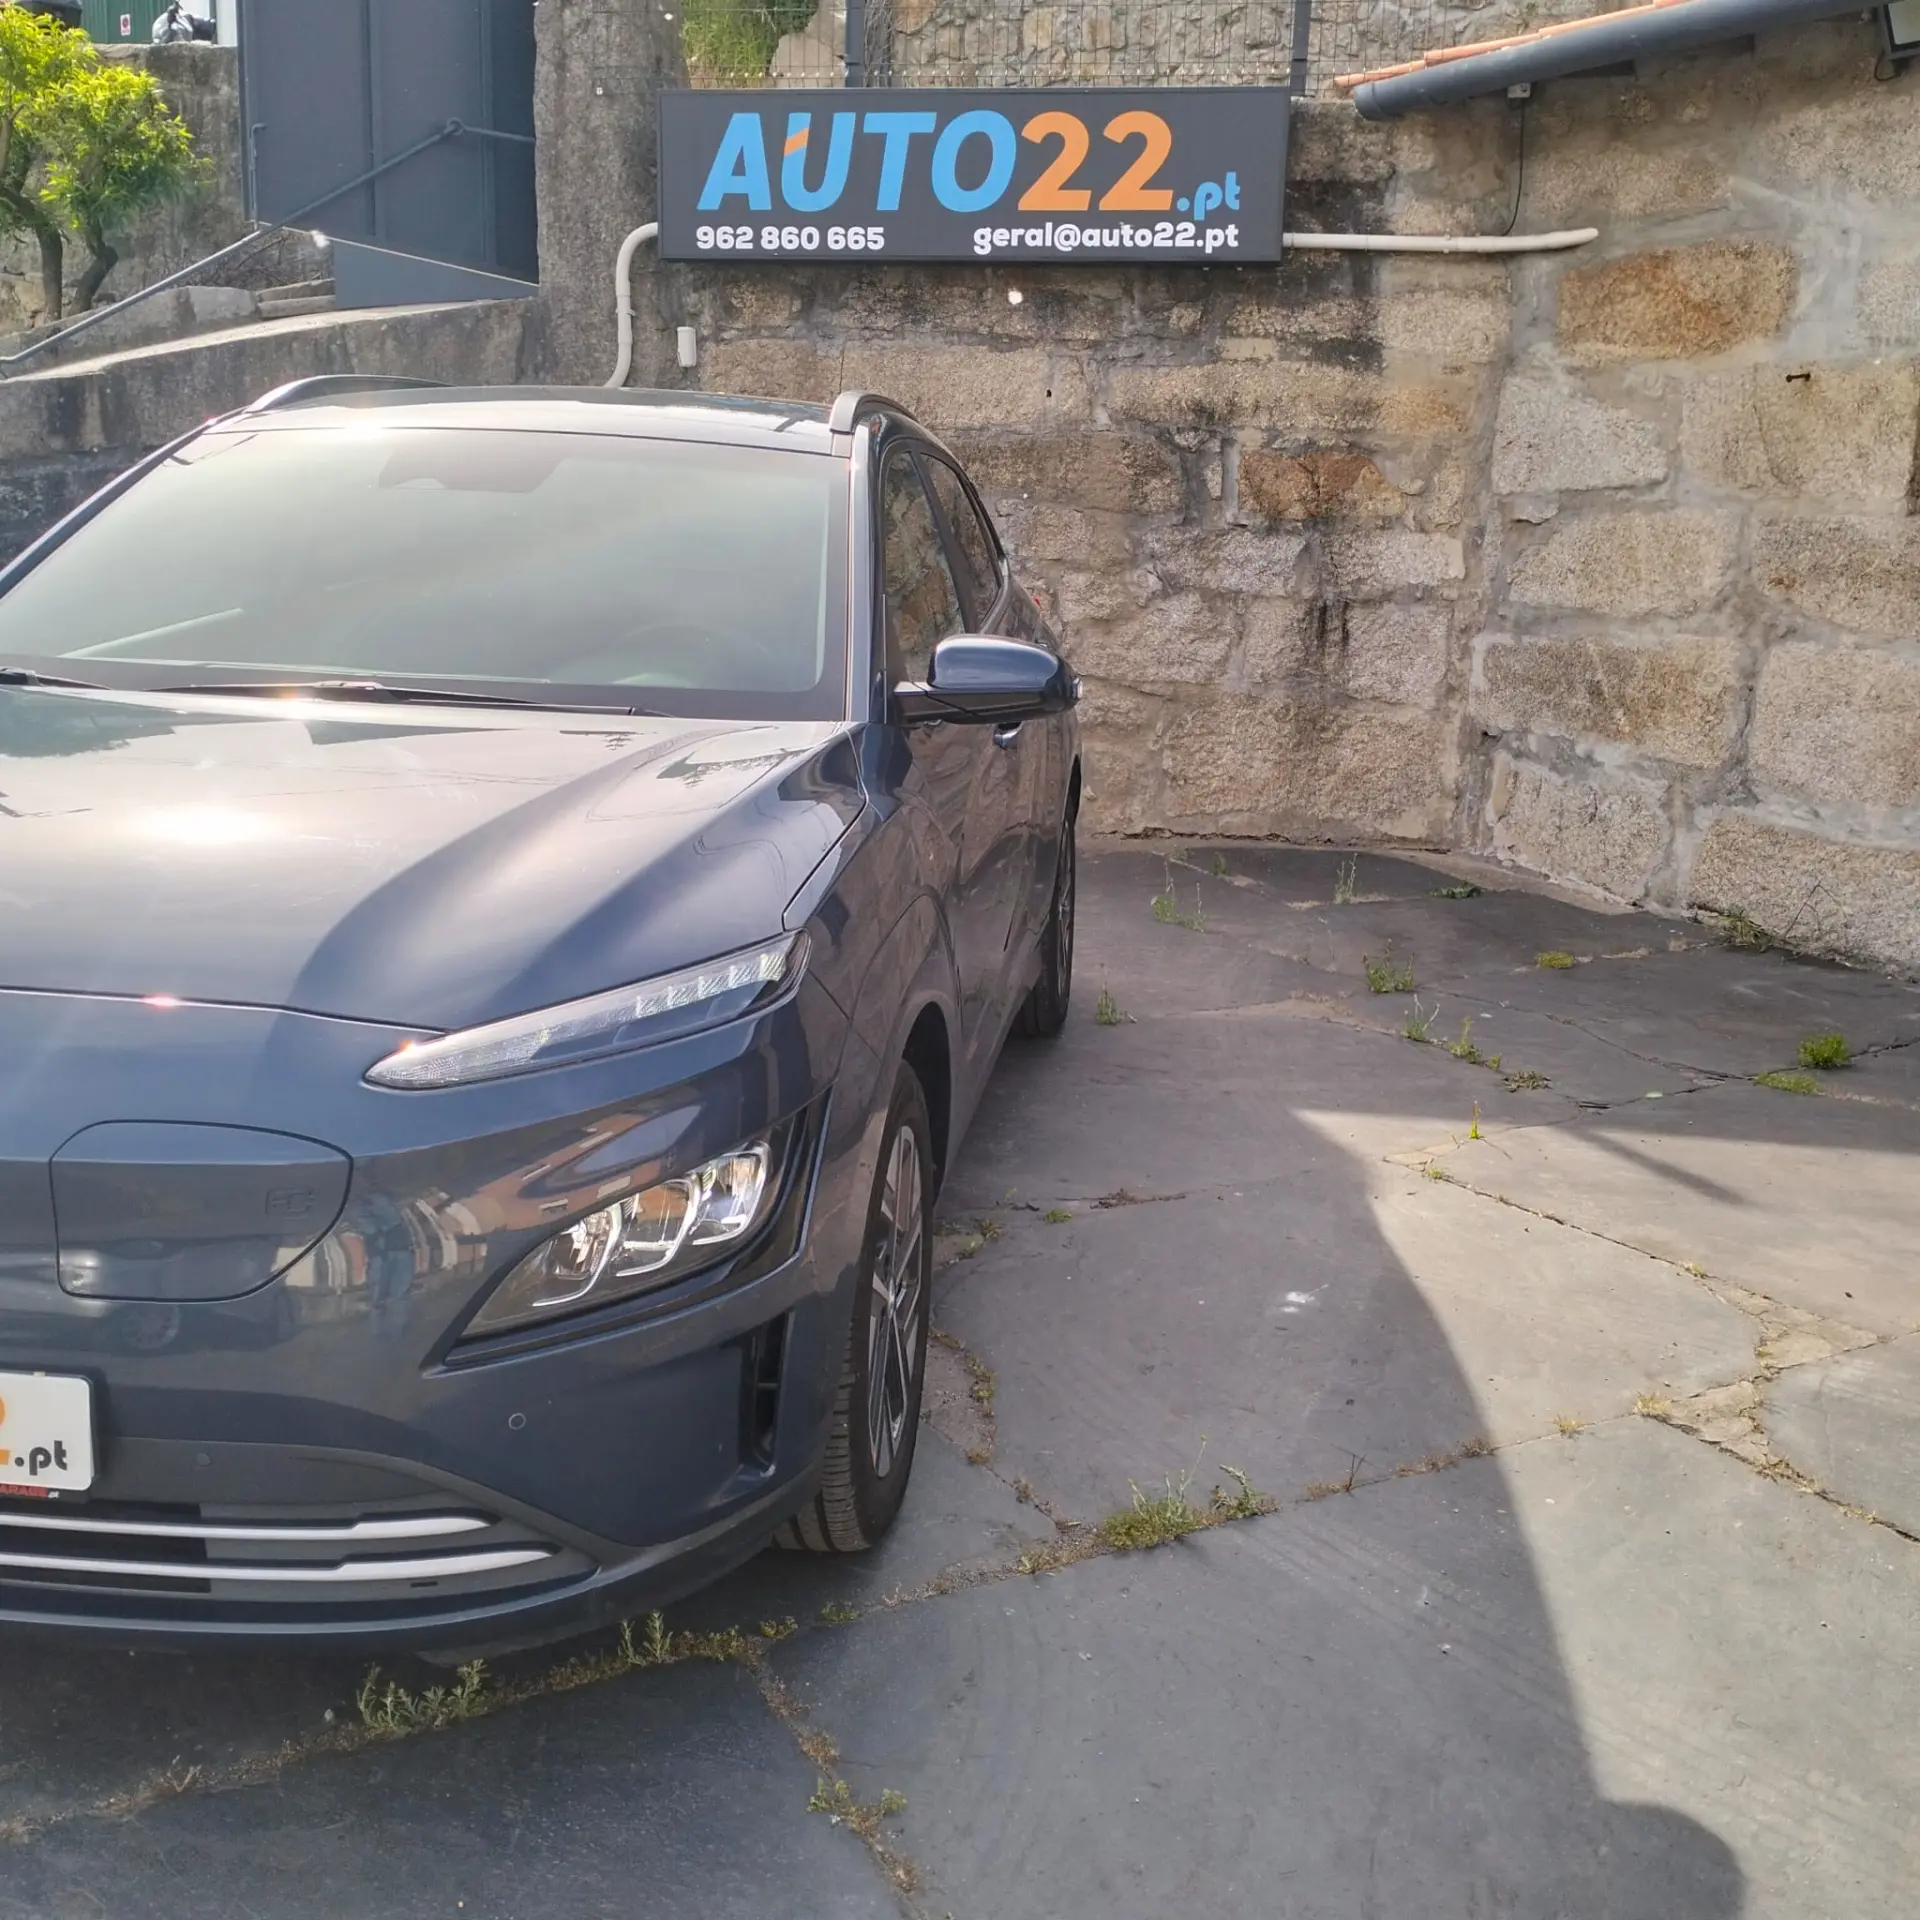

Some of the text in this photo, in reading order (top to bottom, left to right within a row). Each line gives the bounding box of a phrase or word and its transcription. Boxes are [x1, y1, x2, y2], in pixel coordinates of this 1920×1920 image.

[695, 110, 1241, 222] AUTO22.pt
[696, 225, 885, 251] 962 860 665
[973, 222, 1240, 256] geral@auto22.pt
[0, 1396, 68, 1476] .pt
